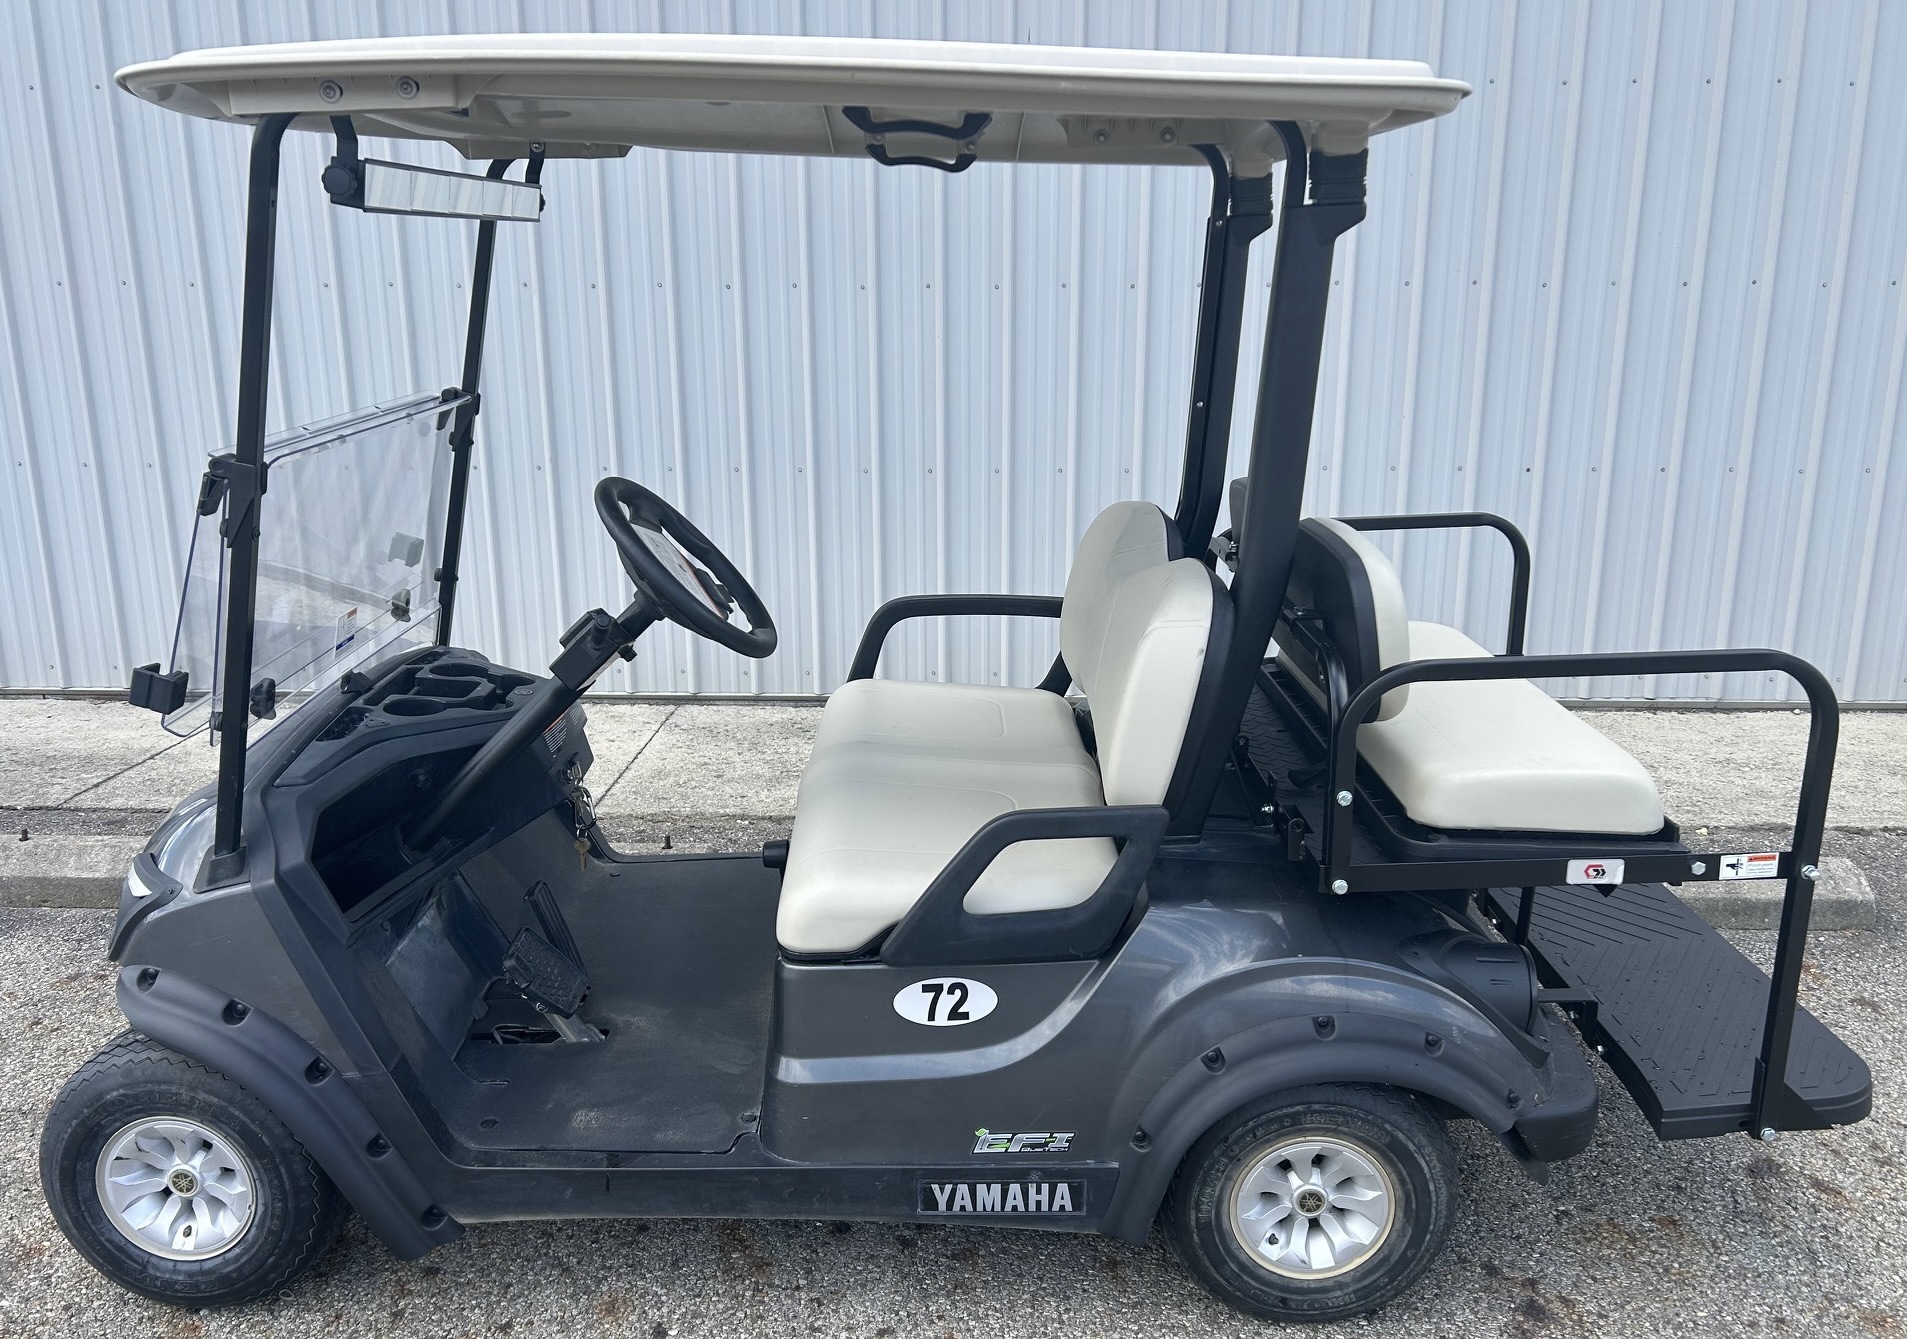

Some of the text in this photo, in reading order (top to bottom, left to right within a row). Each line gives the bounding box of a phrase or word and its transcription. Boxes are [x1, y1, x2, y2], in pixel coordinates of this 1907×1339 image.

[921, 982, 970, 1022] 72
[973, 1131, 1075, 1154] EFI
[931, 1183, 1073, 1212] YAMAHA
